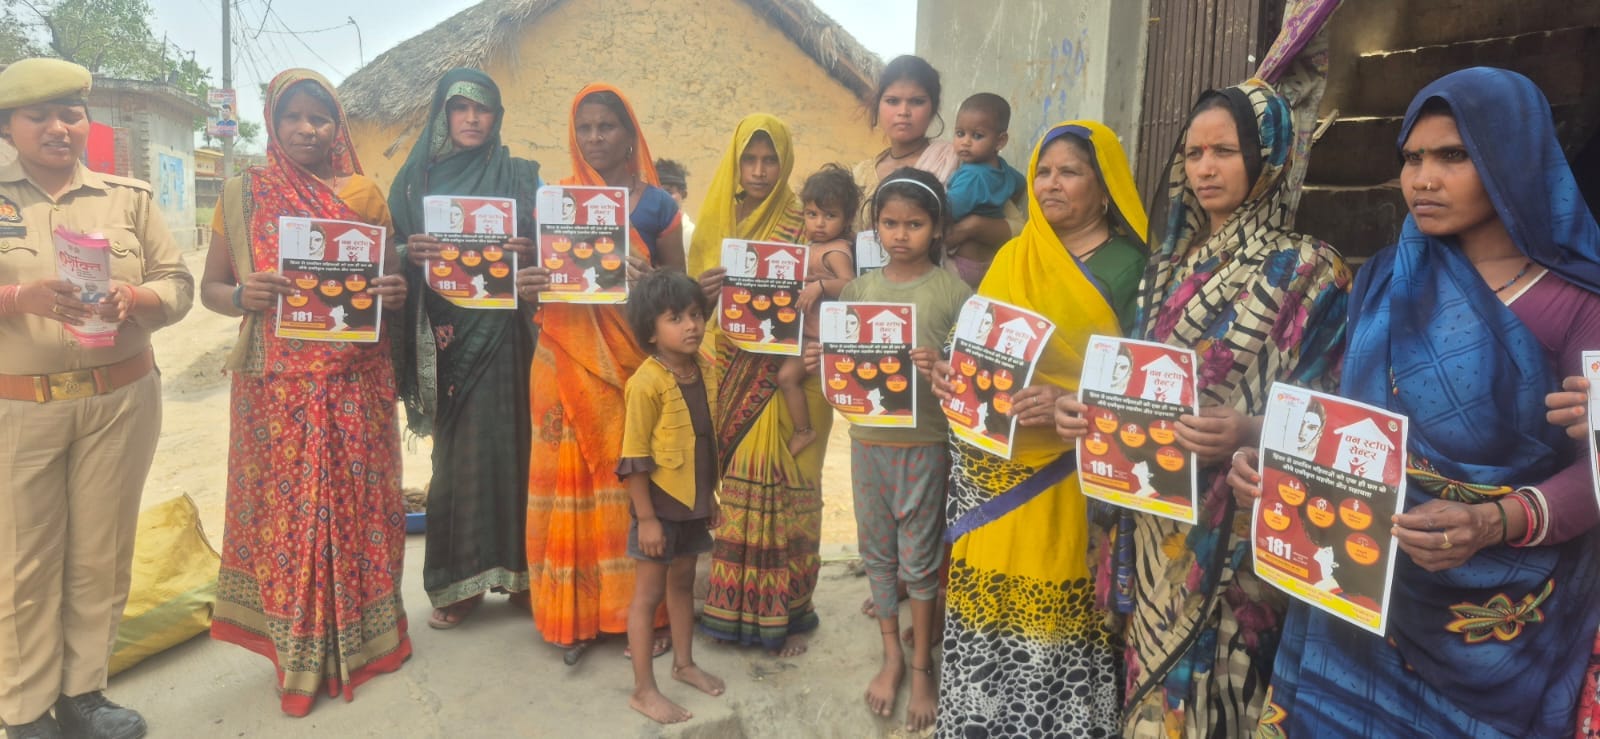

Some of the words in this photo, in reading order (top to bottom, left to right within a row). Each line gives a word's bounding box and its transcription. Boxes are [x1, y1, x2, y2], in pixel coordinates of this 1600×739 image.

[550, 273, 568, 283] 181
[438, 280, 457, 290] 181
[291, 311, 312, 322] 181
[728, 323, 746, 333] 181
[833, 394, 852, 405] 181
[1090, 460, 1113, 478] 181
[1266, 536, 1292, 560] 181
